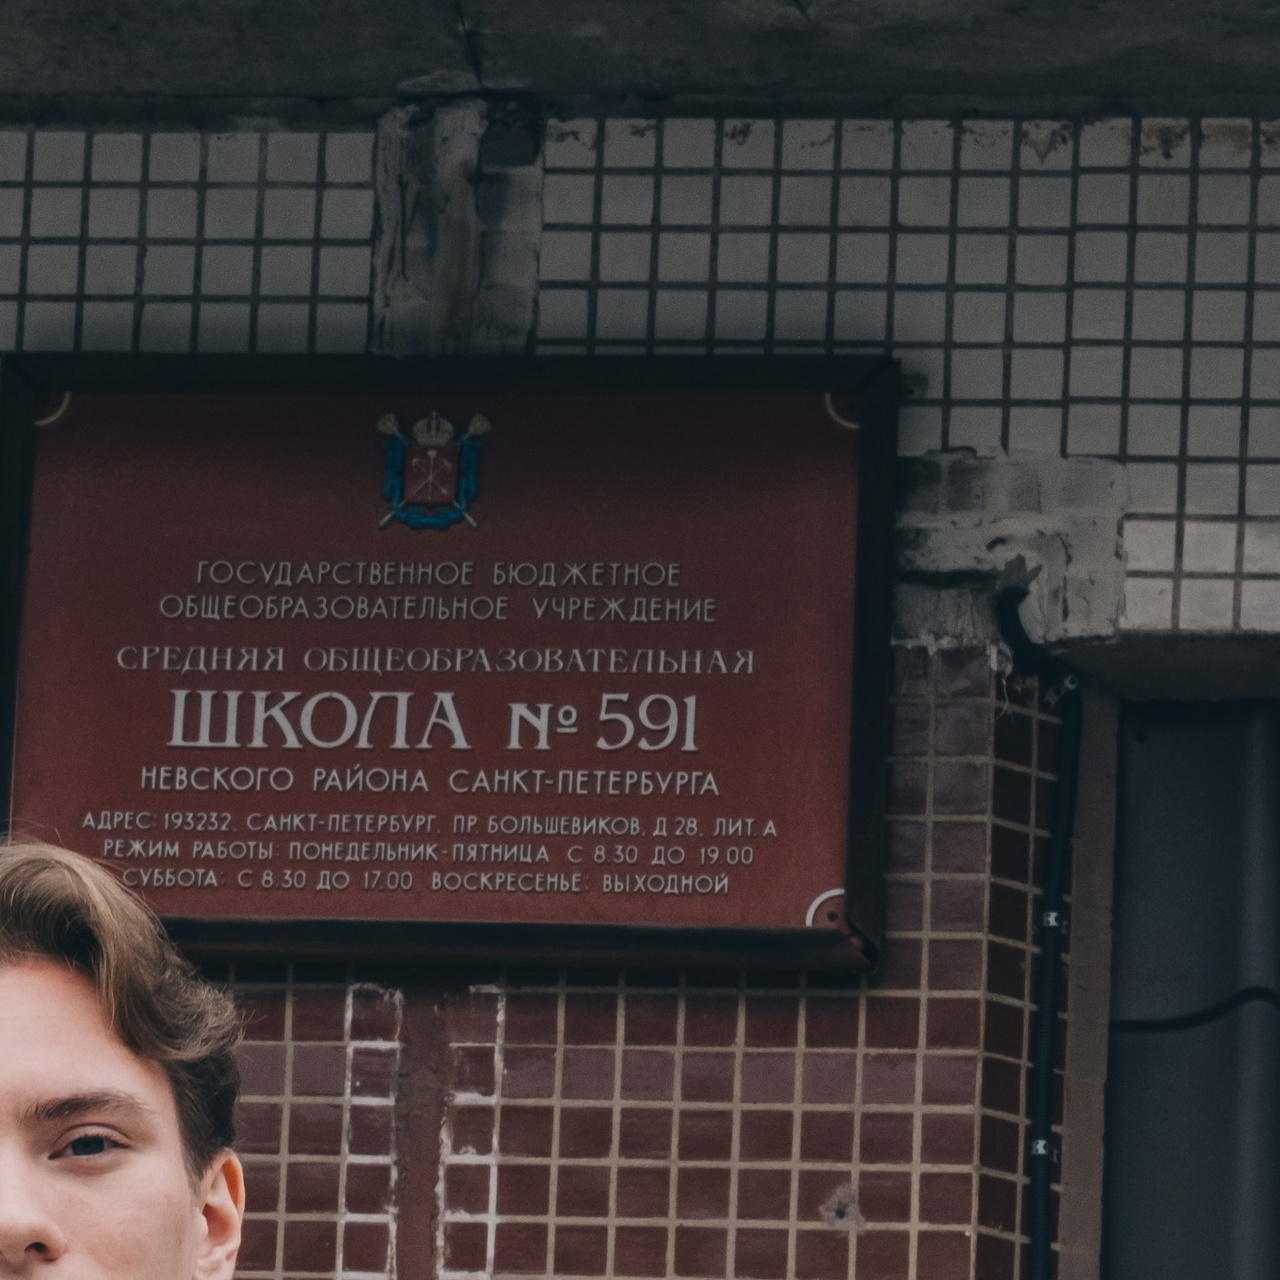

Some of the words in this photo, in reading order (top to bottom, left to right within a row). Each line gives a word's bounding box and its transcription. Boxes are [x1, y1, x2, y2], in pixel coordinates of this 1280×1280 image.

[196, 560, 474, 587] ГОСУДАРСТВЕННОЕ
[492, 561, 681, 588] БЮДЖЕТНОЕ
[159, 594, 509, 621] ОБЩЕОБРАЗОВАТЕЛЬНОЕ
[532, 597, 716, 623] УЧРЕЖДЕНИЕ
[116, 645, 285, 676] СРЕДНЯЯ
[303, 647, 755, 677] ОБЩЕОБРАЗОВАТЕЛЬНАЯ
[167, 688, 471, 750] ШКОЛА
[596, 692, 698, 751] 591
[140, 766, 294, 792] НЕВСКОГО
[312, 764, 430, 793] РАЙОНА
[448, 769, 720, 796] САНКТ-ПЕТЕРБУРГА
[763, 819, 778, 838] А
[103, 839, 180, 860] РЕЖИМ
[567, 845, 584, 864] С
[593, 845, 639, 864] 8.30
[650, 846, 686, 865] ДО
[699, 846, 754, 865] 19.00
[237, 868, 254, 888] С
[261, 868, 307, 889] 8.30
[316, 870, 351, 891] ДО
[363, 870, 413, 890] 17.00
[602, 872, 730, 895] ВЫХОДНОЙ
